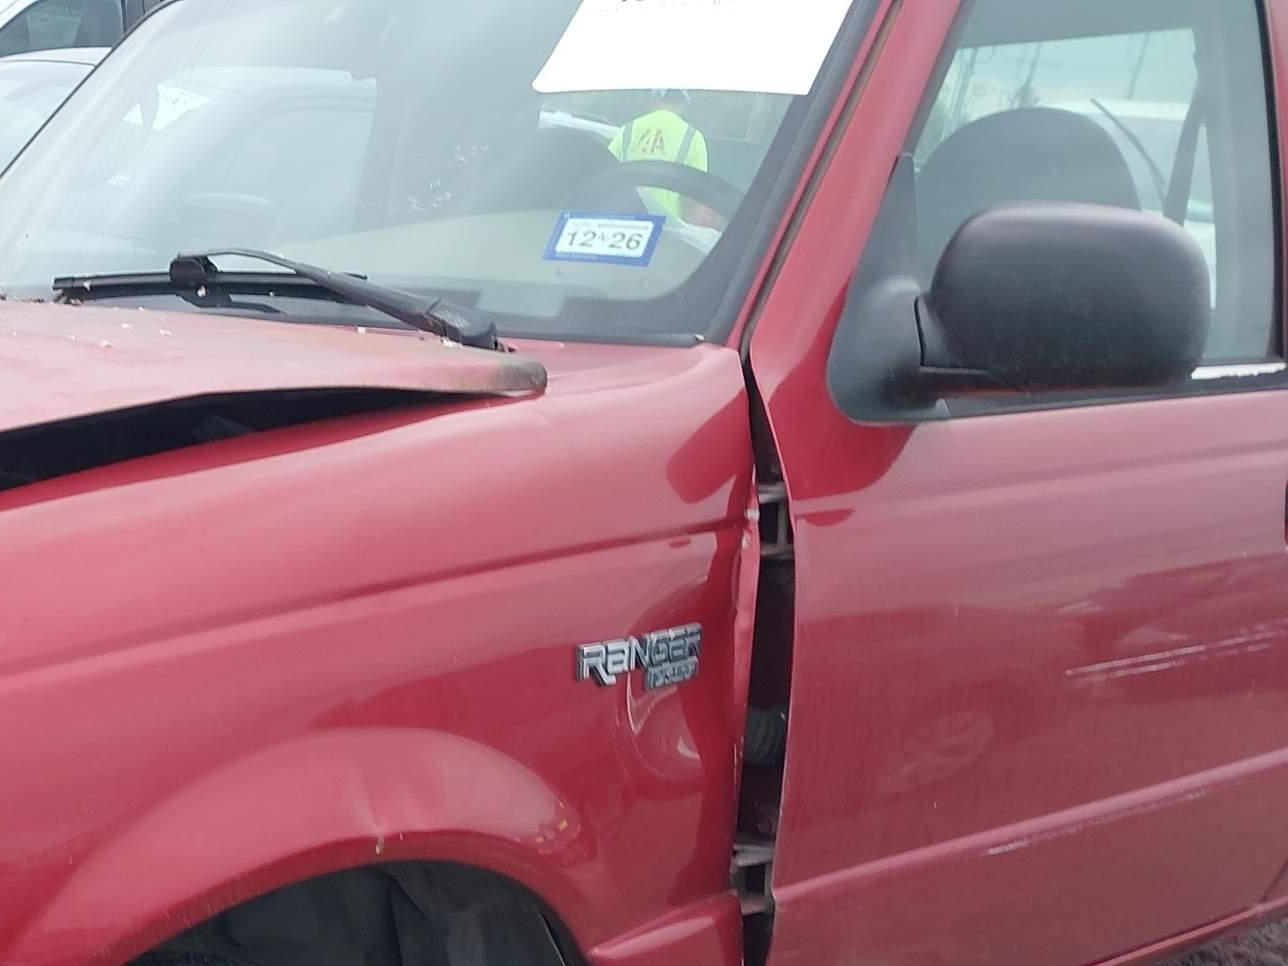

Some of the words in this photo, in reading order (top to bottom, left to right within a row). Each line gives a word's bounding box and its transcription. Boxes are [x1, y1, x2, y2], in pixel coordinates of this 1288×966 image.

[567, 229, 597, 247] 12
[608, 231, 644, 251] 26
[576, 622, 703, 686] RANGER
